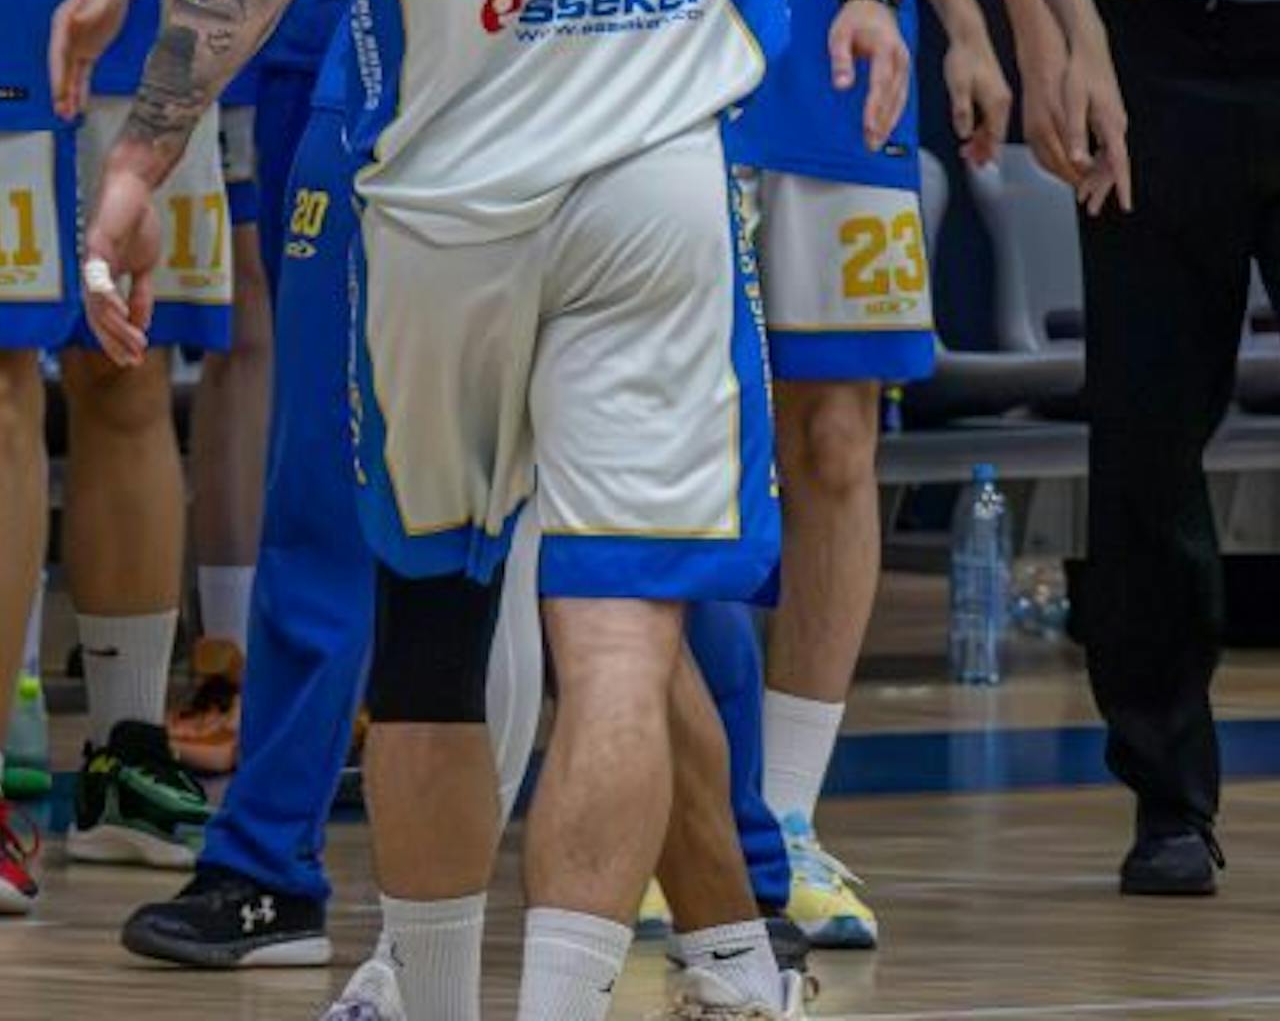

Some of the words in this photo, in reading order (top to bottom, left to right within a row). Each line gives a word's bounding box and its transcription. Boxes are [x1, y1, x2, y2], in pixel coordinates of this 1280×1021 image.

[167, 191, 225, 271] 17
[290, 187, 329, 237] 20
[838, 208, 927, 299] 23
